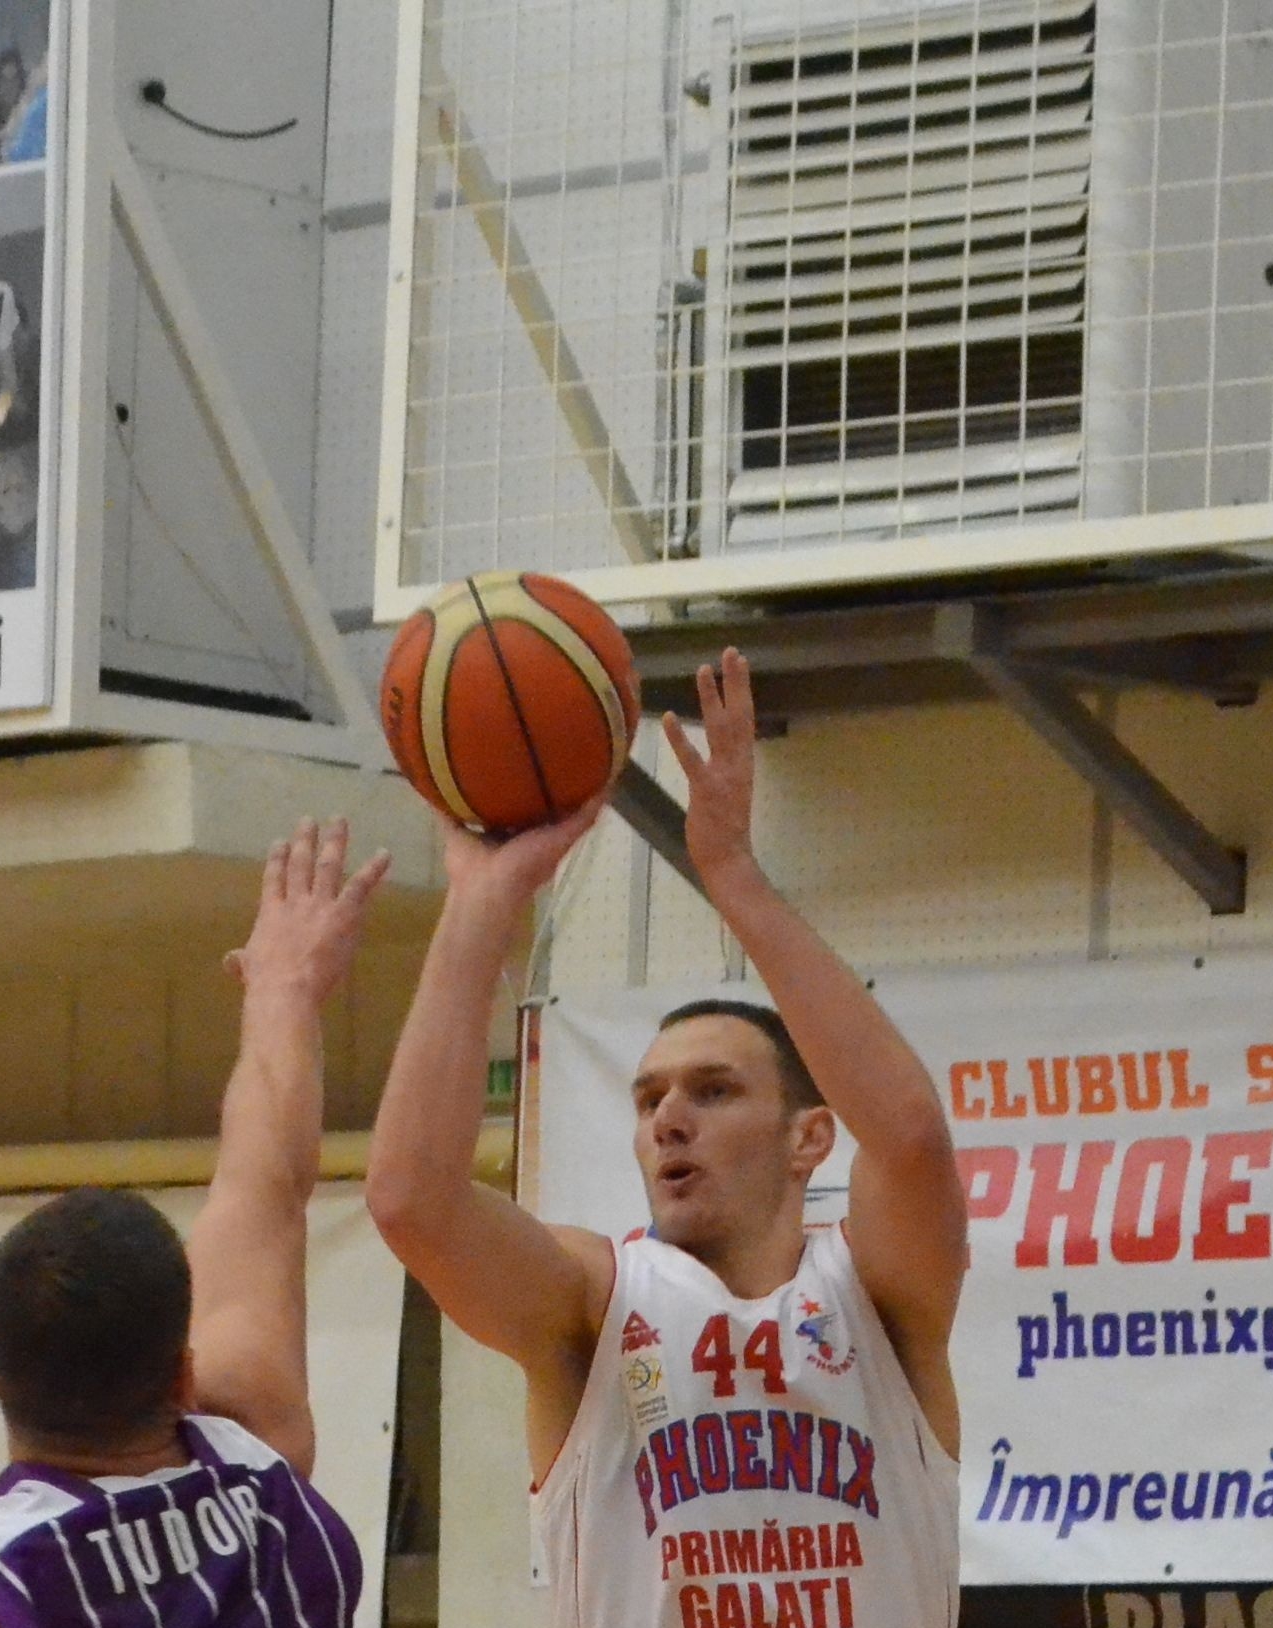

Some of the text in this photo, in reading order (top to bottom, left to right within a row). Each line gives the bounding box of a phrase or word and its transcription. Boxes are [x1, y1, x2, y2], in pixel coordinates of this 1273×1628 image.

[949, 1048, 1210, 1121] CLUBUL
[690, 1312, 788, 1399] 44
[634, 1408, 880, 1540] PHOENIX
[85, 1484, 259, 1595] TUDOR
[661, 1518, 864, 1581] PRIMĂRIA
